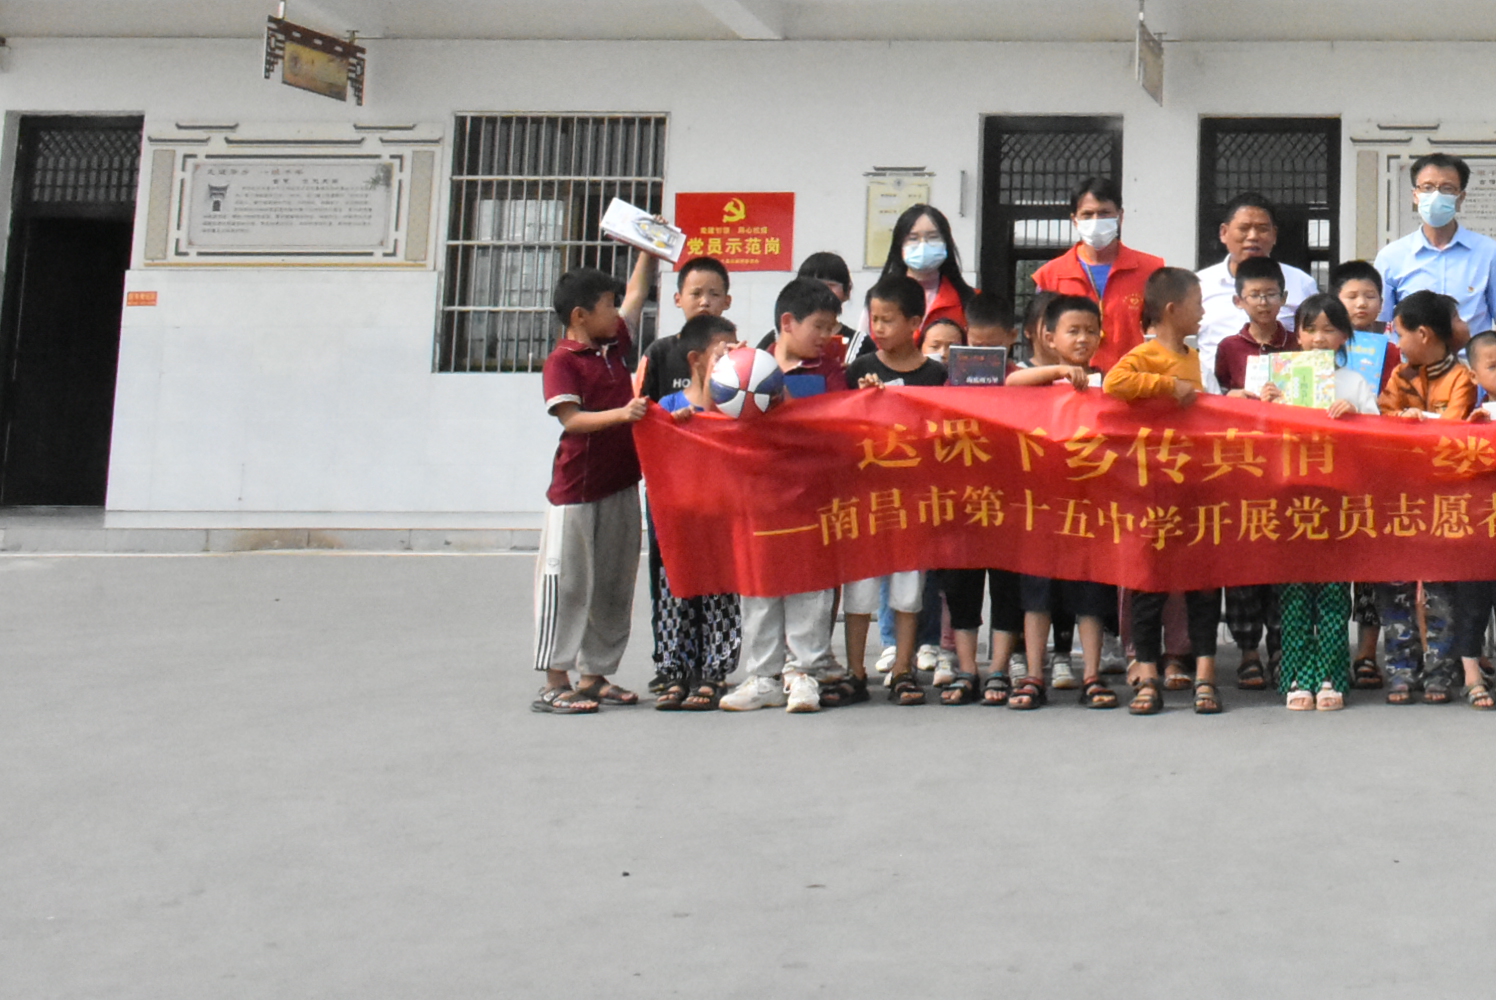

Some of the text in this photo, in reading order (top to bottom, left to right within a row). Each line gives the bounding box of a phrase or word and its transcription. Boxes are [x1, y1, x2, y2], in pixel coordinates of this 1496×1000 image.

[686, 237, 781, 256] 党员示范岗
